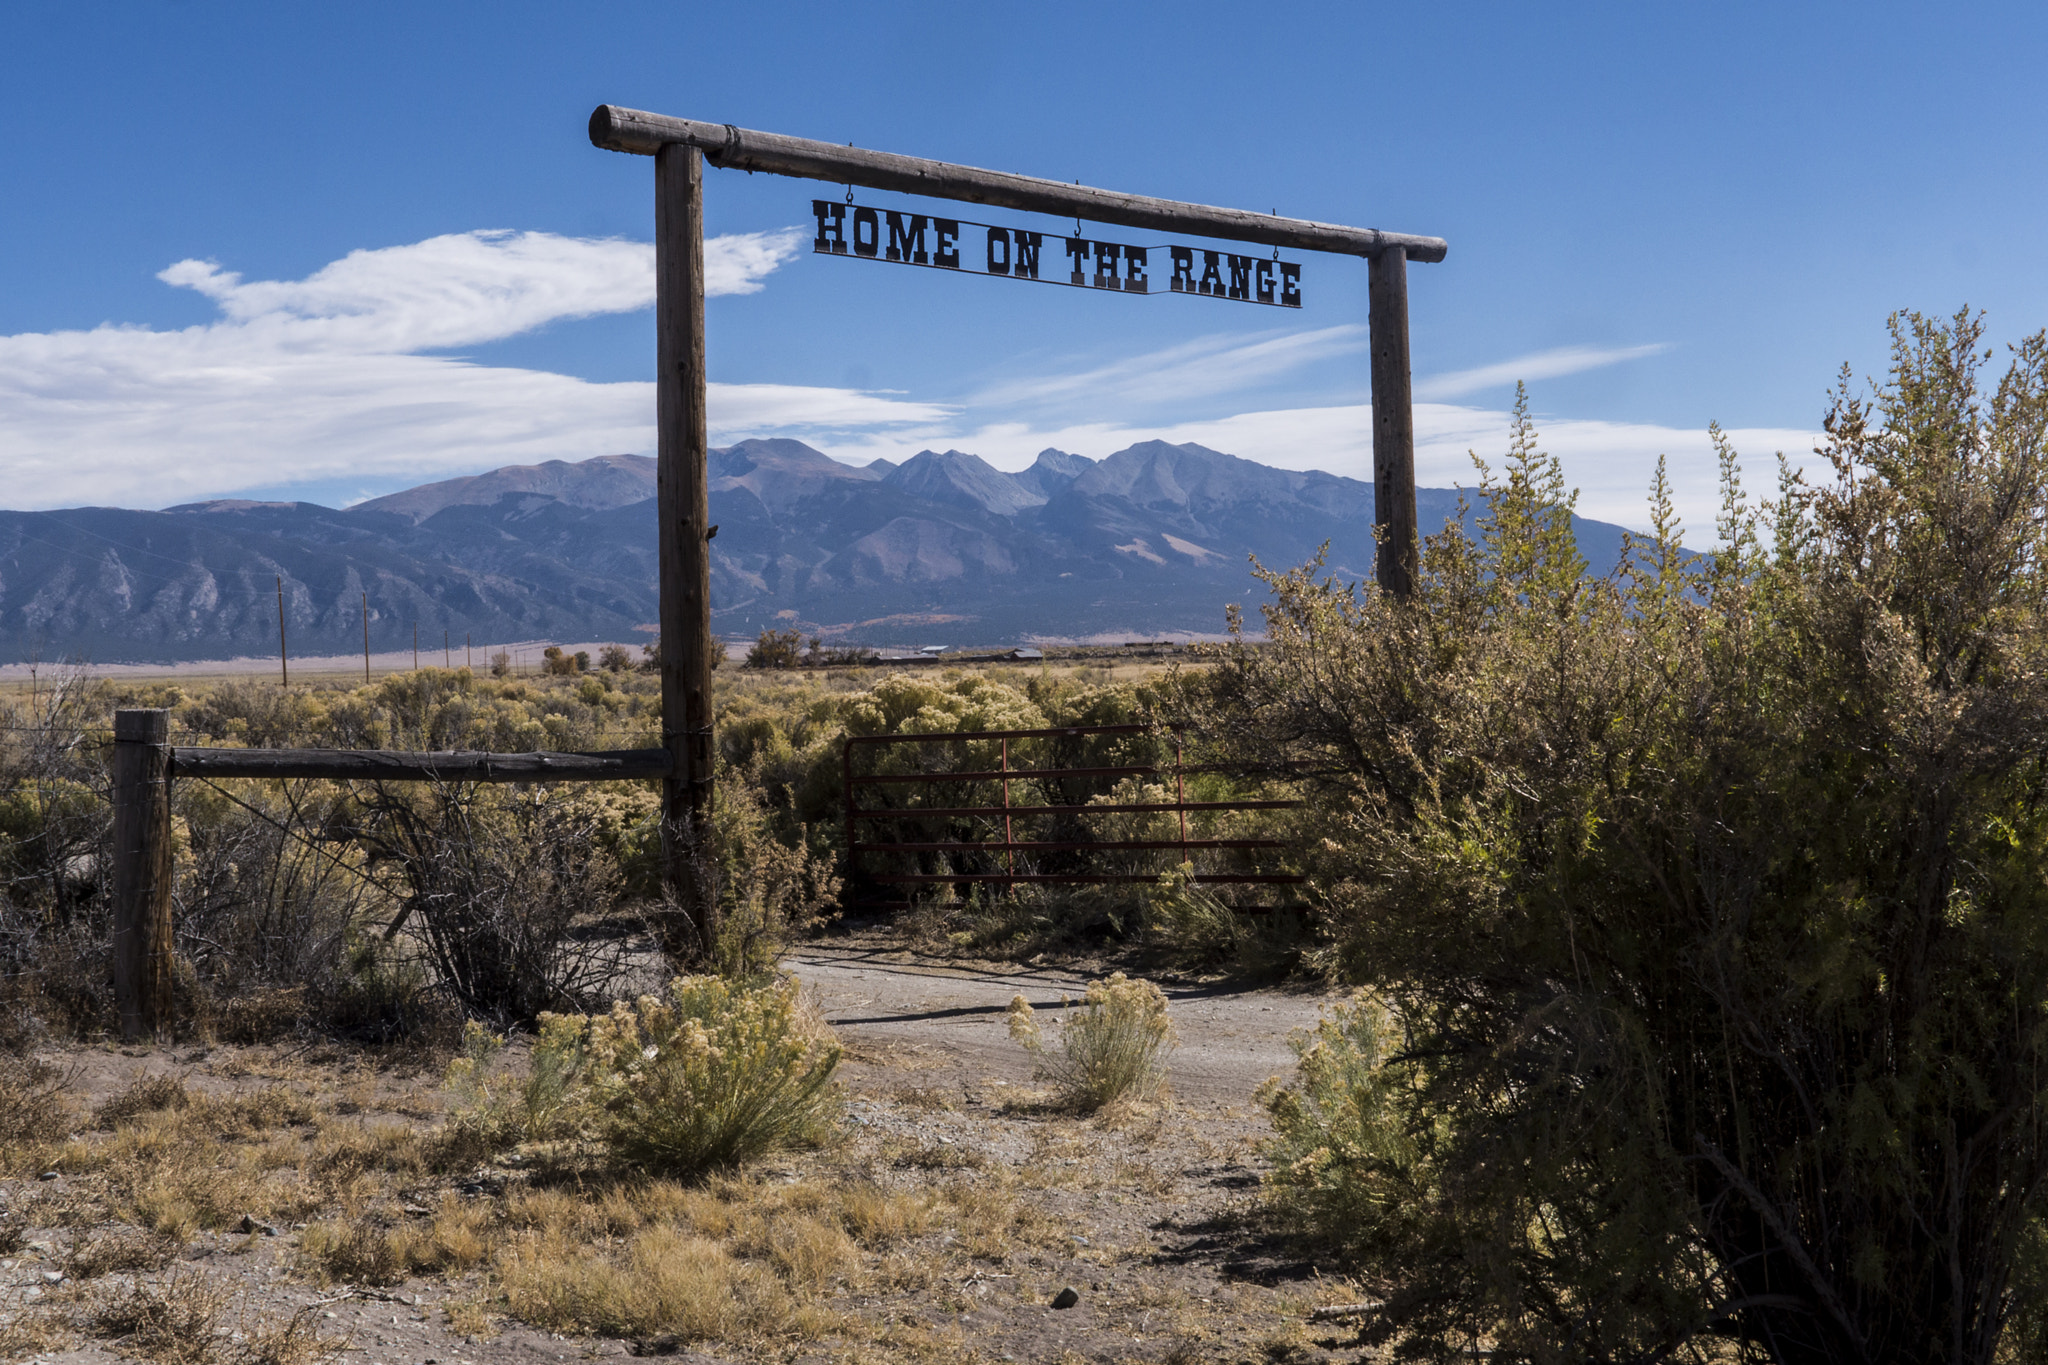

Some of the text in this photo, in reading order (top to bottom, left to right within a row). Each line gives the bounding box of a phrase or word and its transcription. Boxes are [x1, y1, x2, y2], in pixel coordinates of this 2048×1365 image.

[813, 201, 1302, 307] HOME ON THE RANGE
